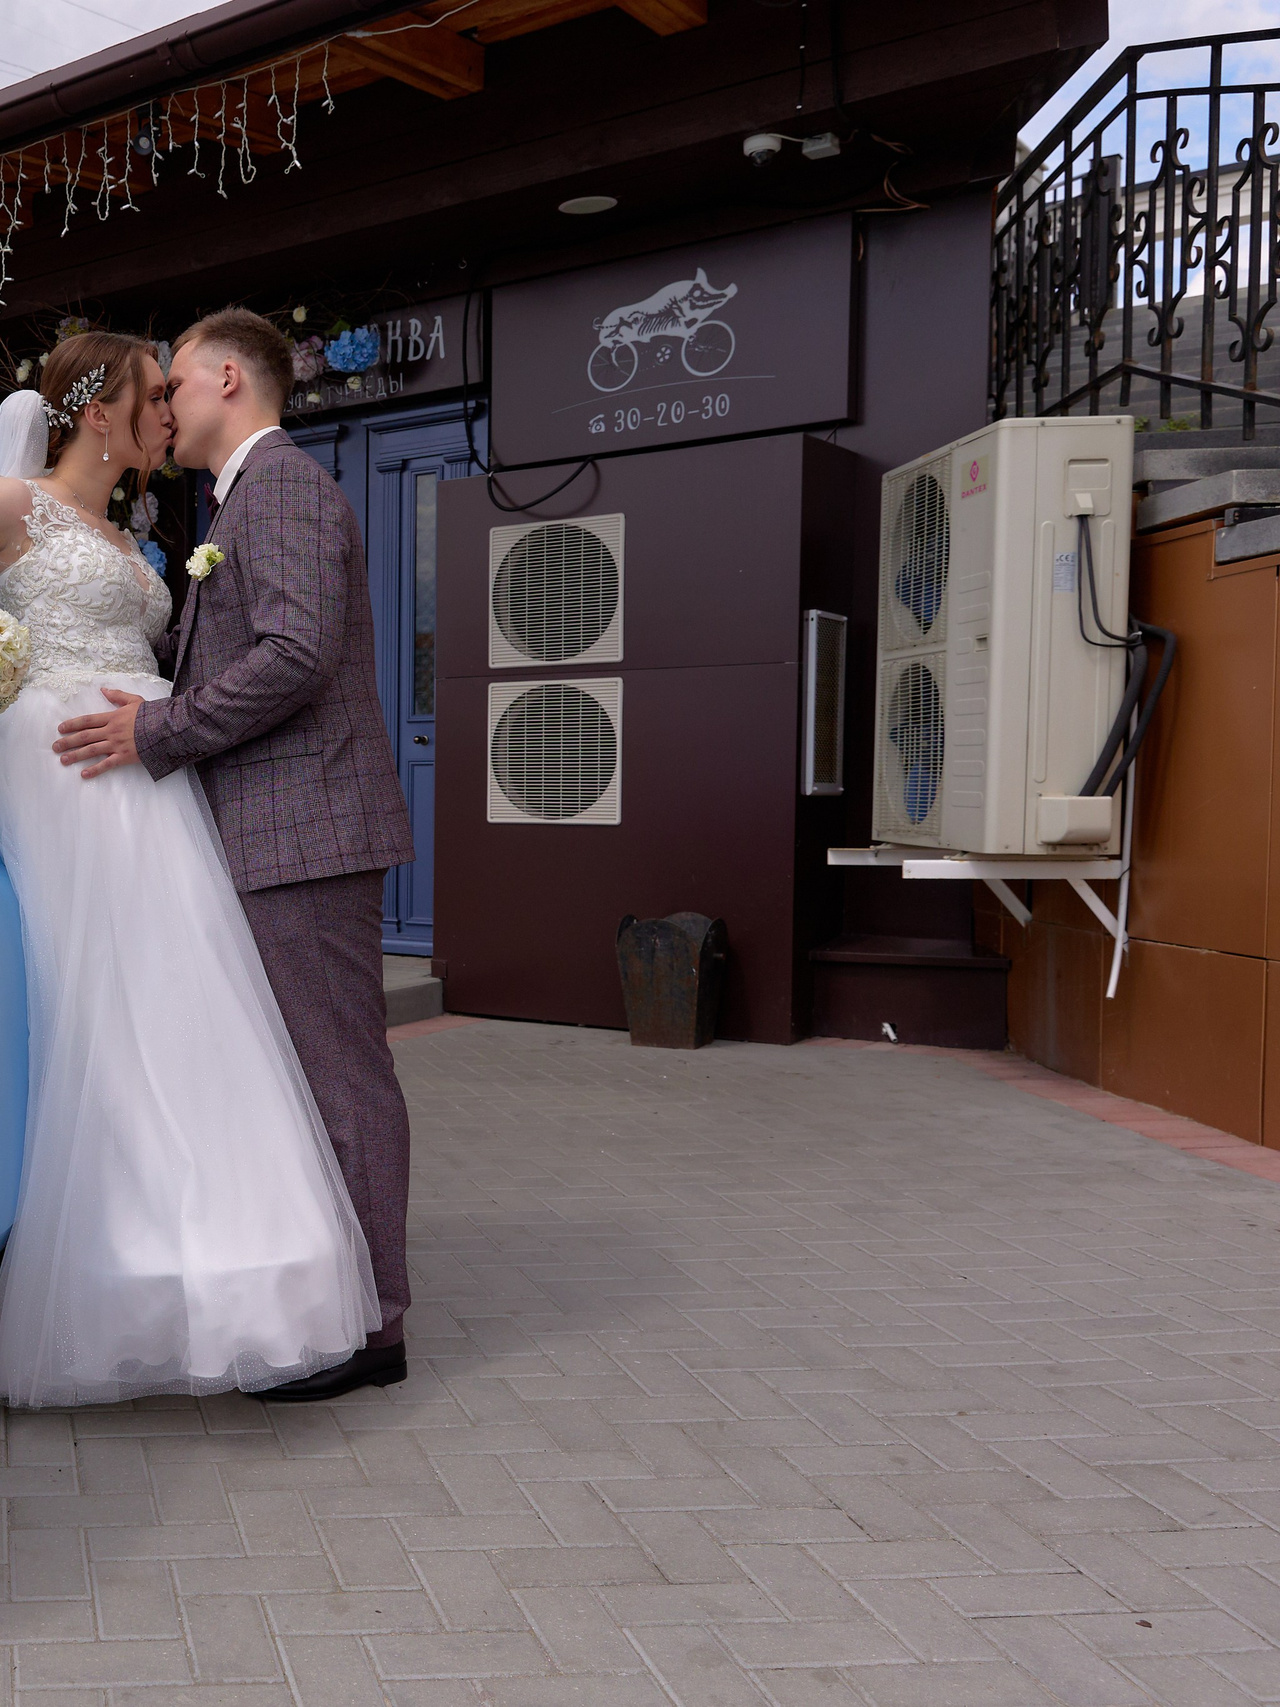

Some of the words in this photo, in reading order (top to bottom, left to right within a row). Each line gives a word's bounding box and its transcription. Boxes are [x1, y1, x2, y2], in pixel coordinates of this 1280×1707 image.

[362, 315, 446, 364] КВА
[614, 393, 730, 433] 30-20-30
[961, 483, 987, 499] DANTEX
